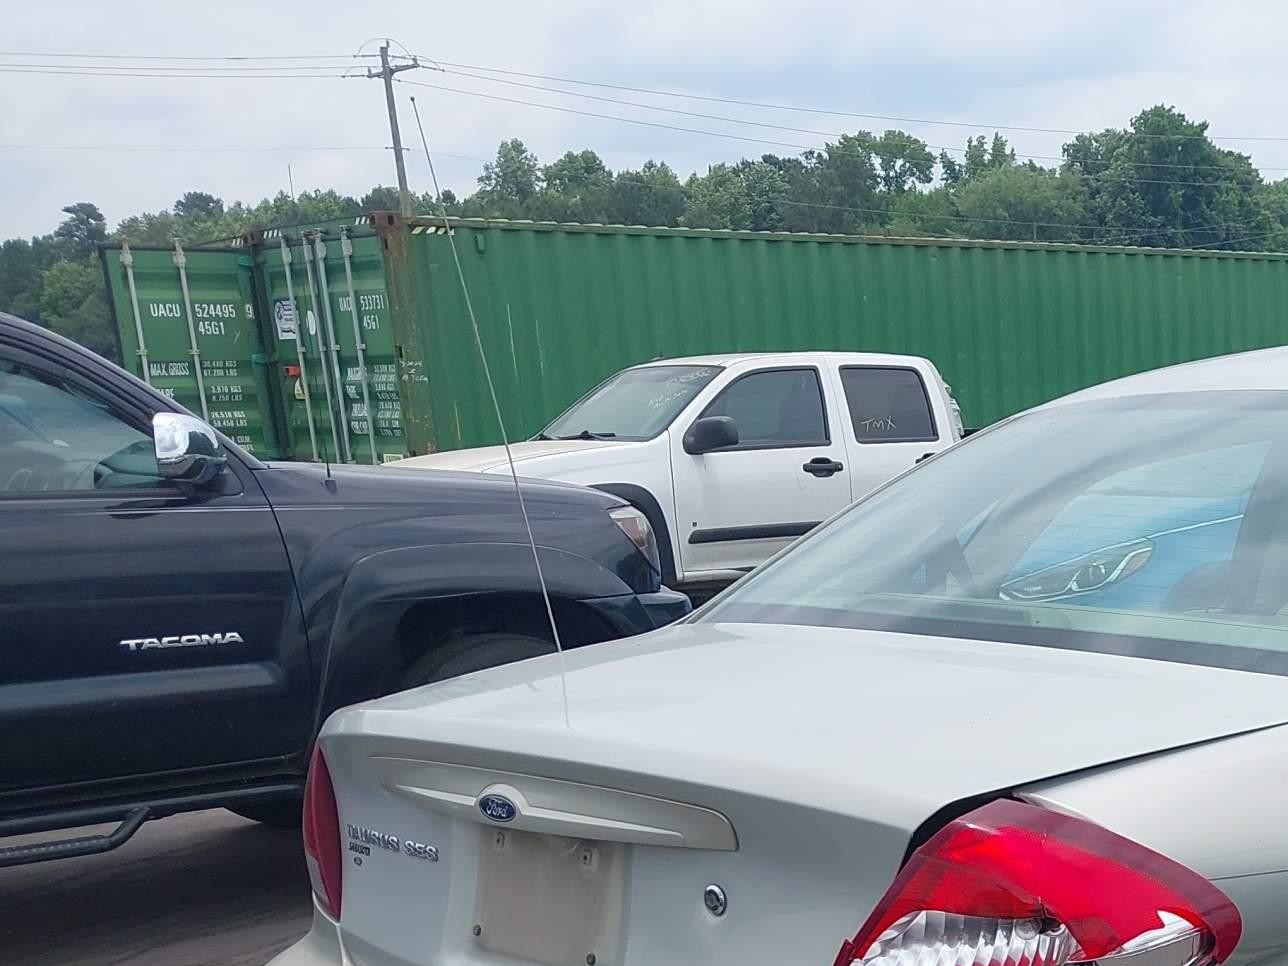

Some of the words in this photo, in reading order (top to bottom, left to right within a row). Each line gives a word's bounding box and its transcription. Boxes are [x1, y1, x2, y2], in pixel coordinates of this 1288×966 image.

[150, 303, 181, 317] UACU
[194, 303, 236, 318] 524495
[199, 321, 225, 335] 45G1
[169, 362, 189, 376] GROSS
[861, 416, 896, 430] TMX
[120, 632, 244, 651] TACOMA
[404, 840, 440, 862] SES
